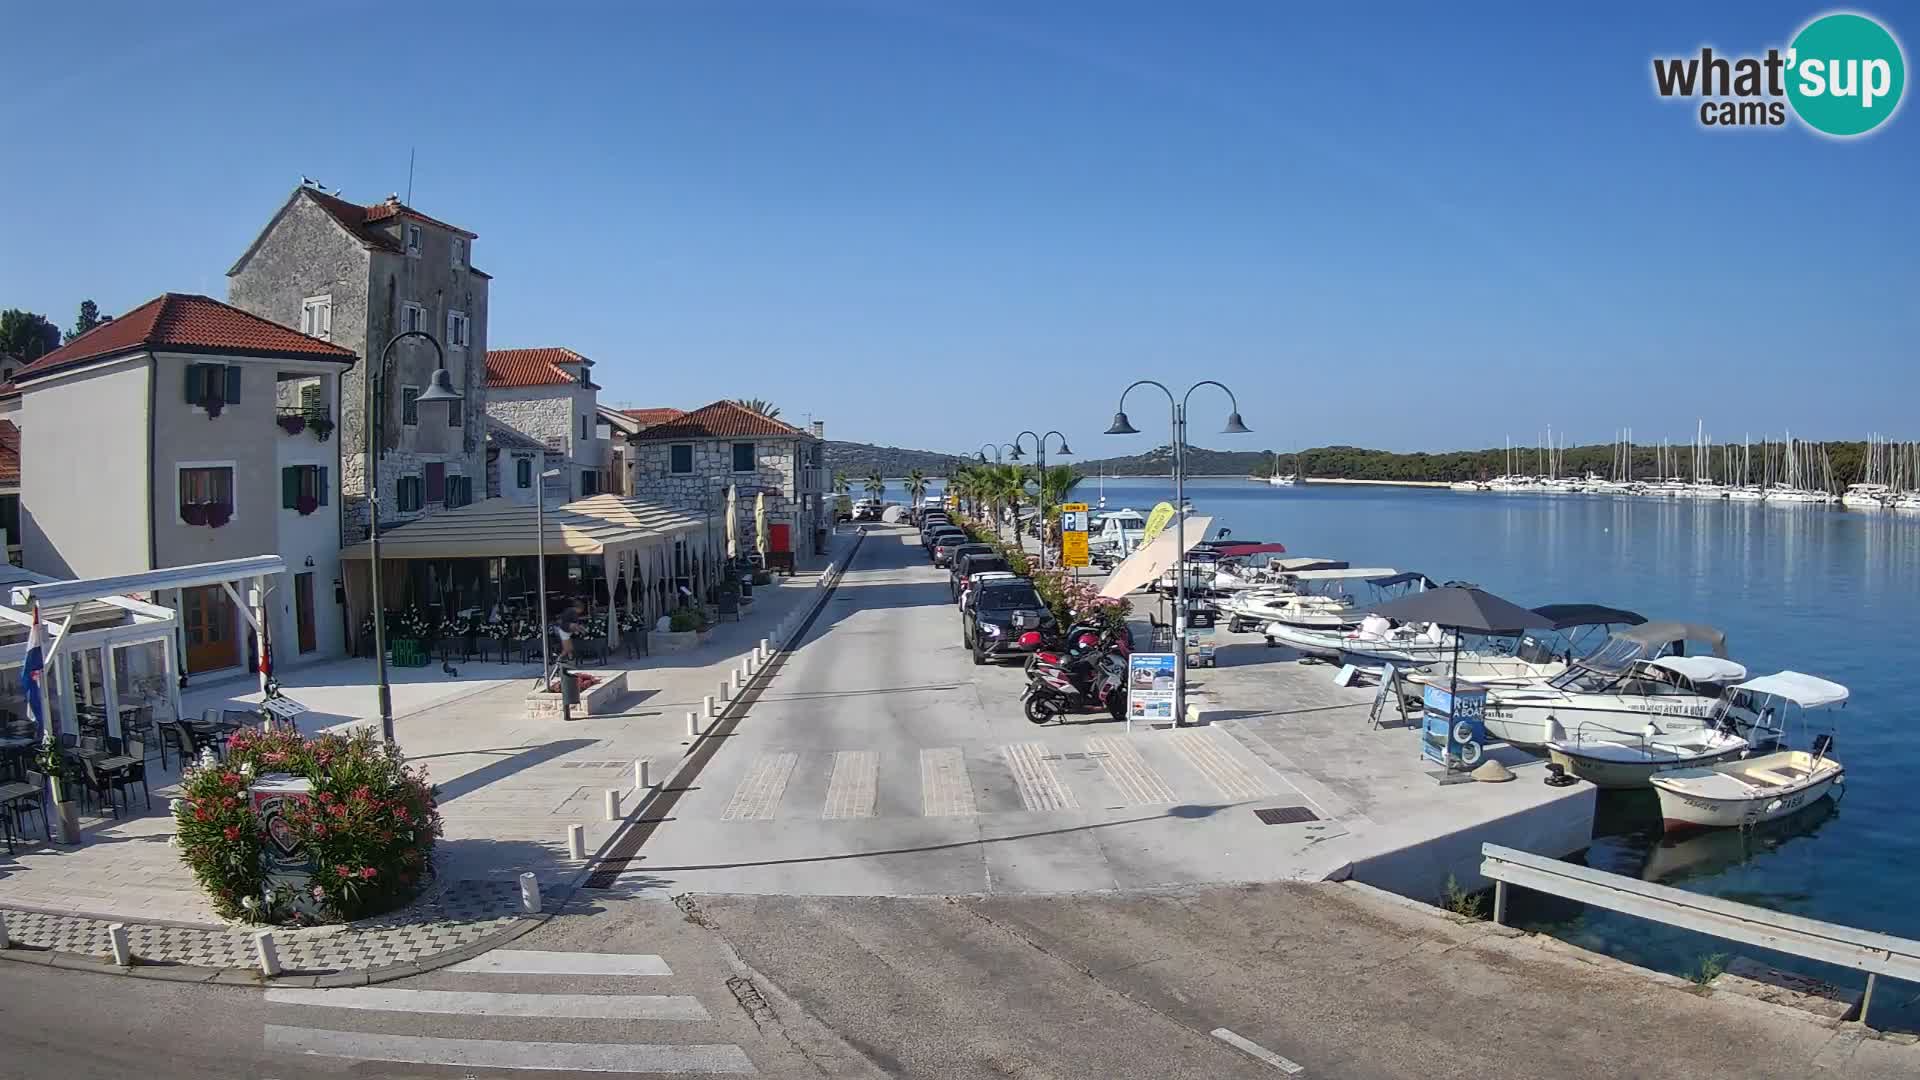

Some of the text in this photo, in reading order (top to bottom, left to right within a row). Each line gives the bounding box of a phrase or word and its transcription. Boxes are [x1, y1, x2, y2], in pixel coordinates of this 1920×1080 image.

[1064, 513, 1075, 530] P
[1453, 696, 1484, 709] RENT
[1461, 707, 1483, 717] BOAT
[1664, 704, 1682, 714] RENT
